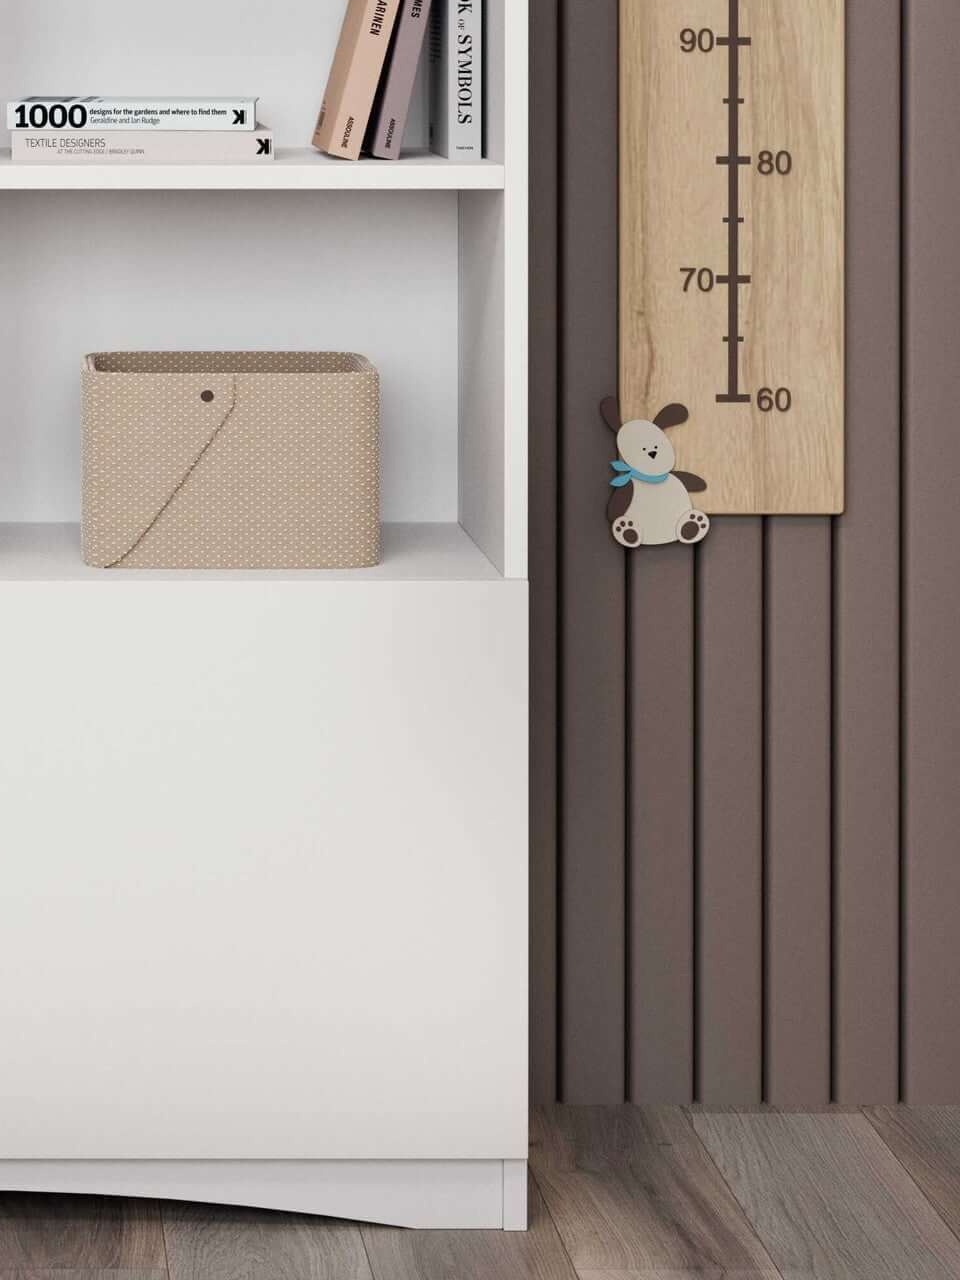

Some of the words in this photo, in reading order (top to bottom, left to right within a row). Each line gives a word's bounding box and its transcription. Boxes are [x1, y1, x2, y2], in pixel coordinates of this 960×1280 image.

[680, 28, 714, 52] 90
[457, 34, 473, 125] SYMBOLS
[14, 104, 87, 128] 1000
[89, 109, 113, 117] designs
[134, 109, 158, 117] gardens
[25, 138, 57, 148] TEXTILE
[60, 138, 106, 148] DESIGNERS
[757, 151, 792, 175] 80
[680, 268, 714, 291] 70
[757, 388, 792, 412] 60
